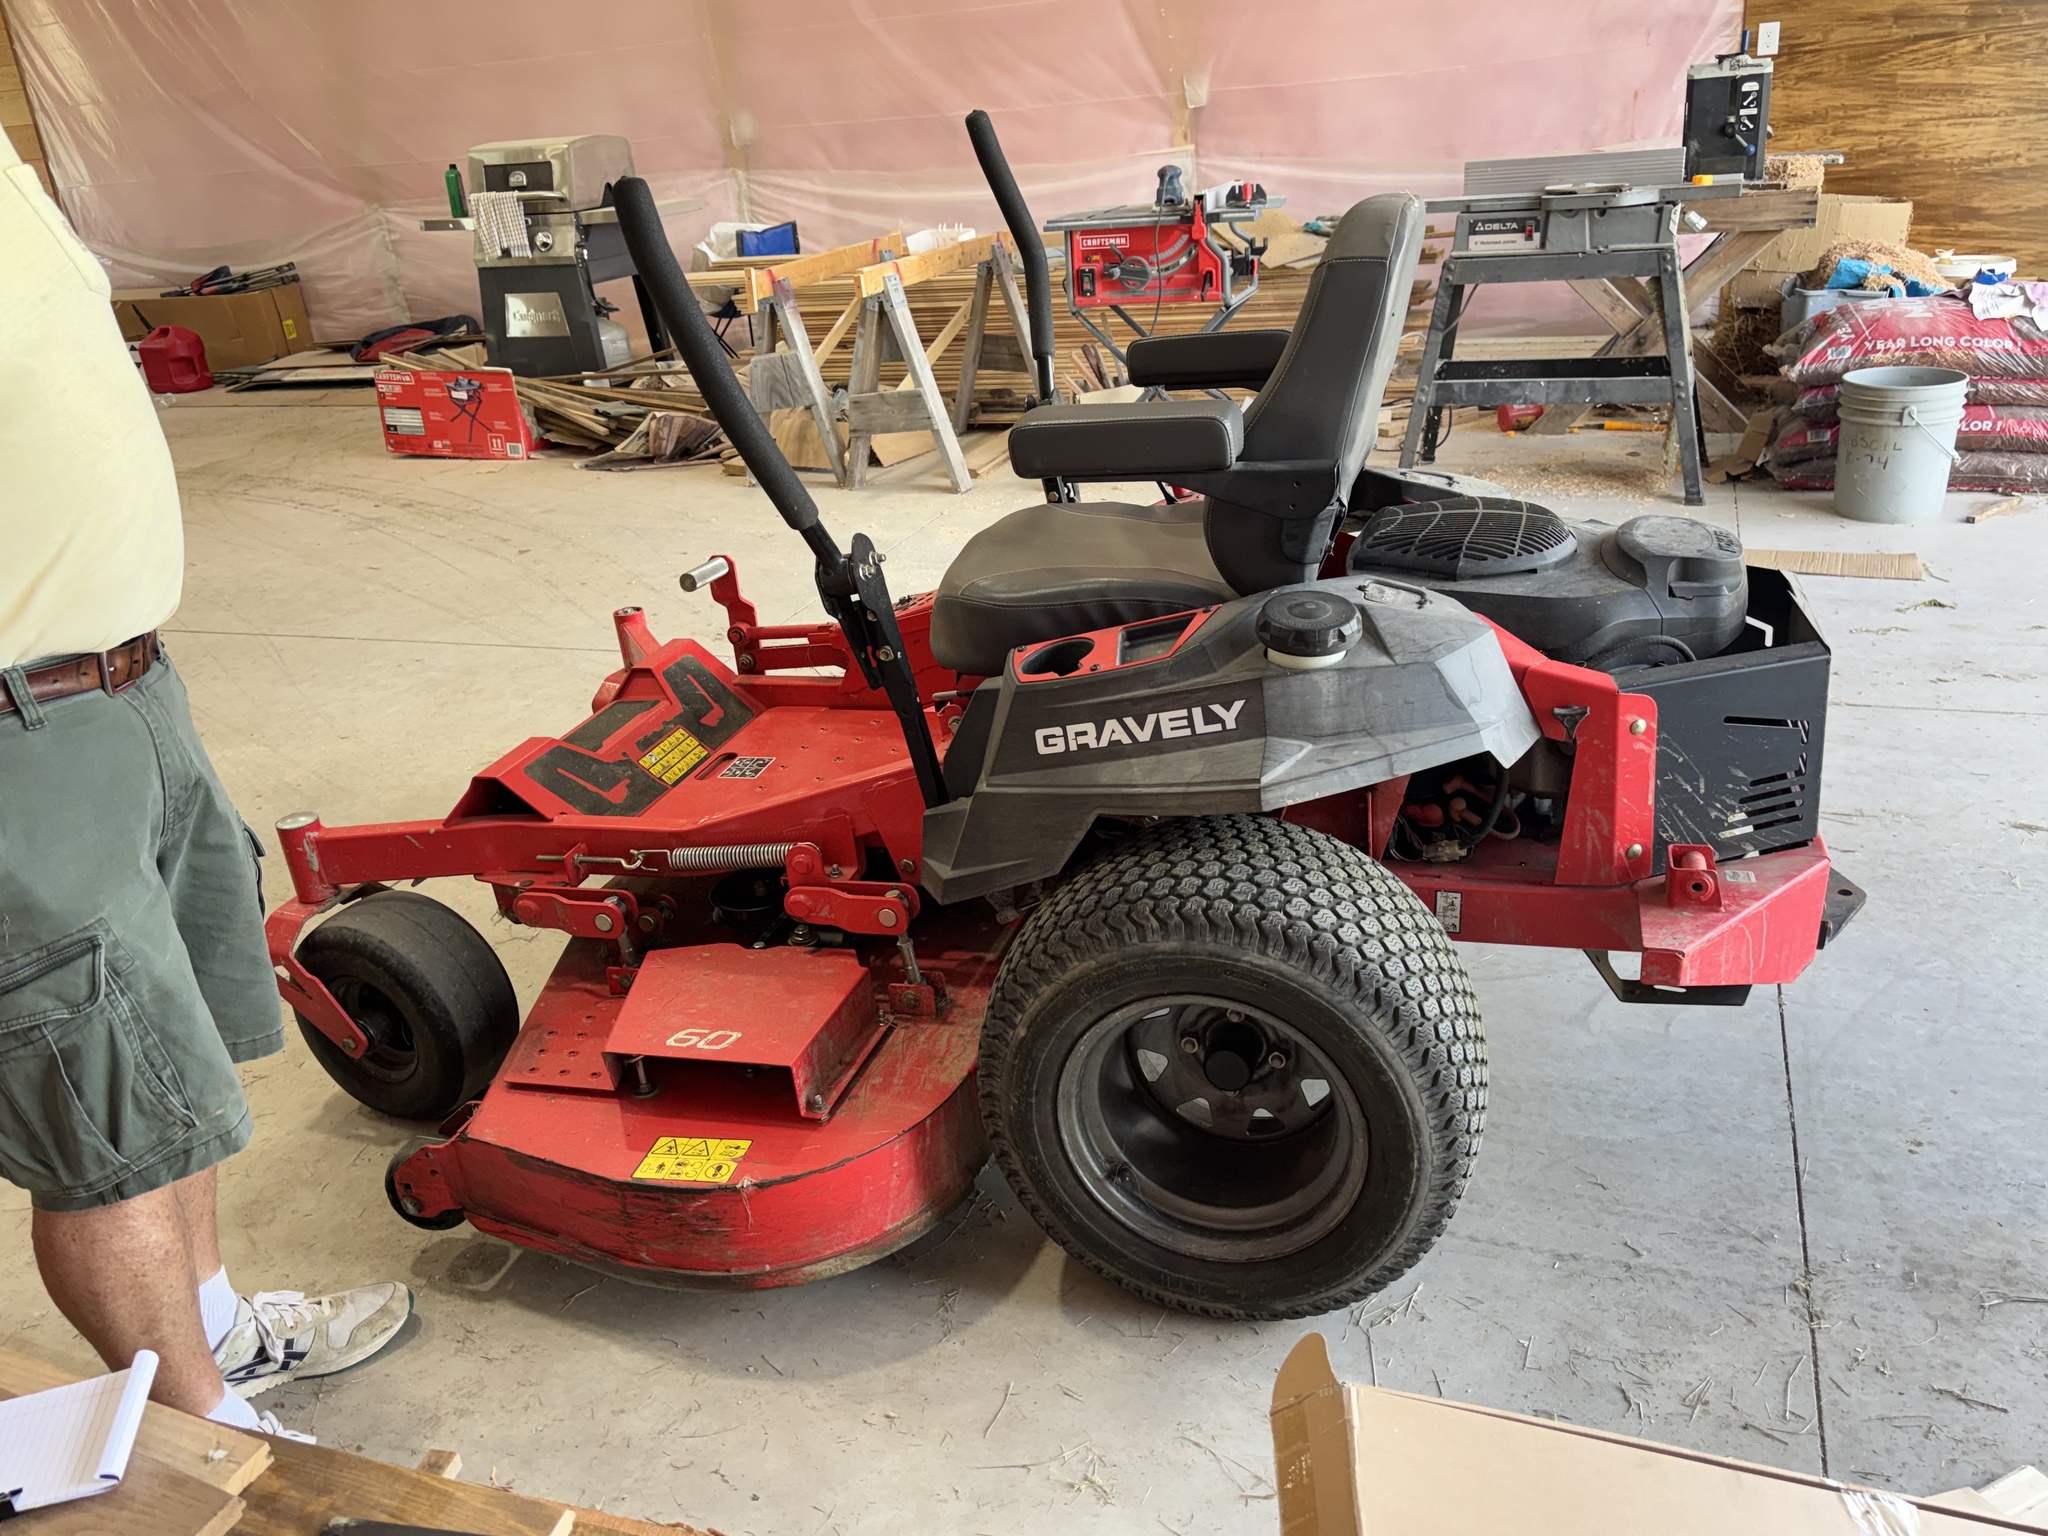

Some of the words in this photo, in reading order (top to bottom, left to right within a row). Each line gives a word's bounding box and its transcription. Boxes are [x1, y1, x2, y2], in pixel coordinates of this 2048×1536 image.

[1484, 222, 1518, 231] DELTA
[1082, 237, 1126, 247] CRAFTSMAN
[1865, 337, 1906, 350] YEAR
[1910, 335, 1956, 348] LONG
[1034, 700, 1247, 756] GRAVELY
[665, 1028, 743, 1050] 60
